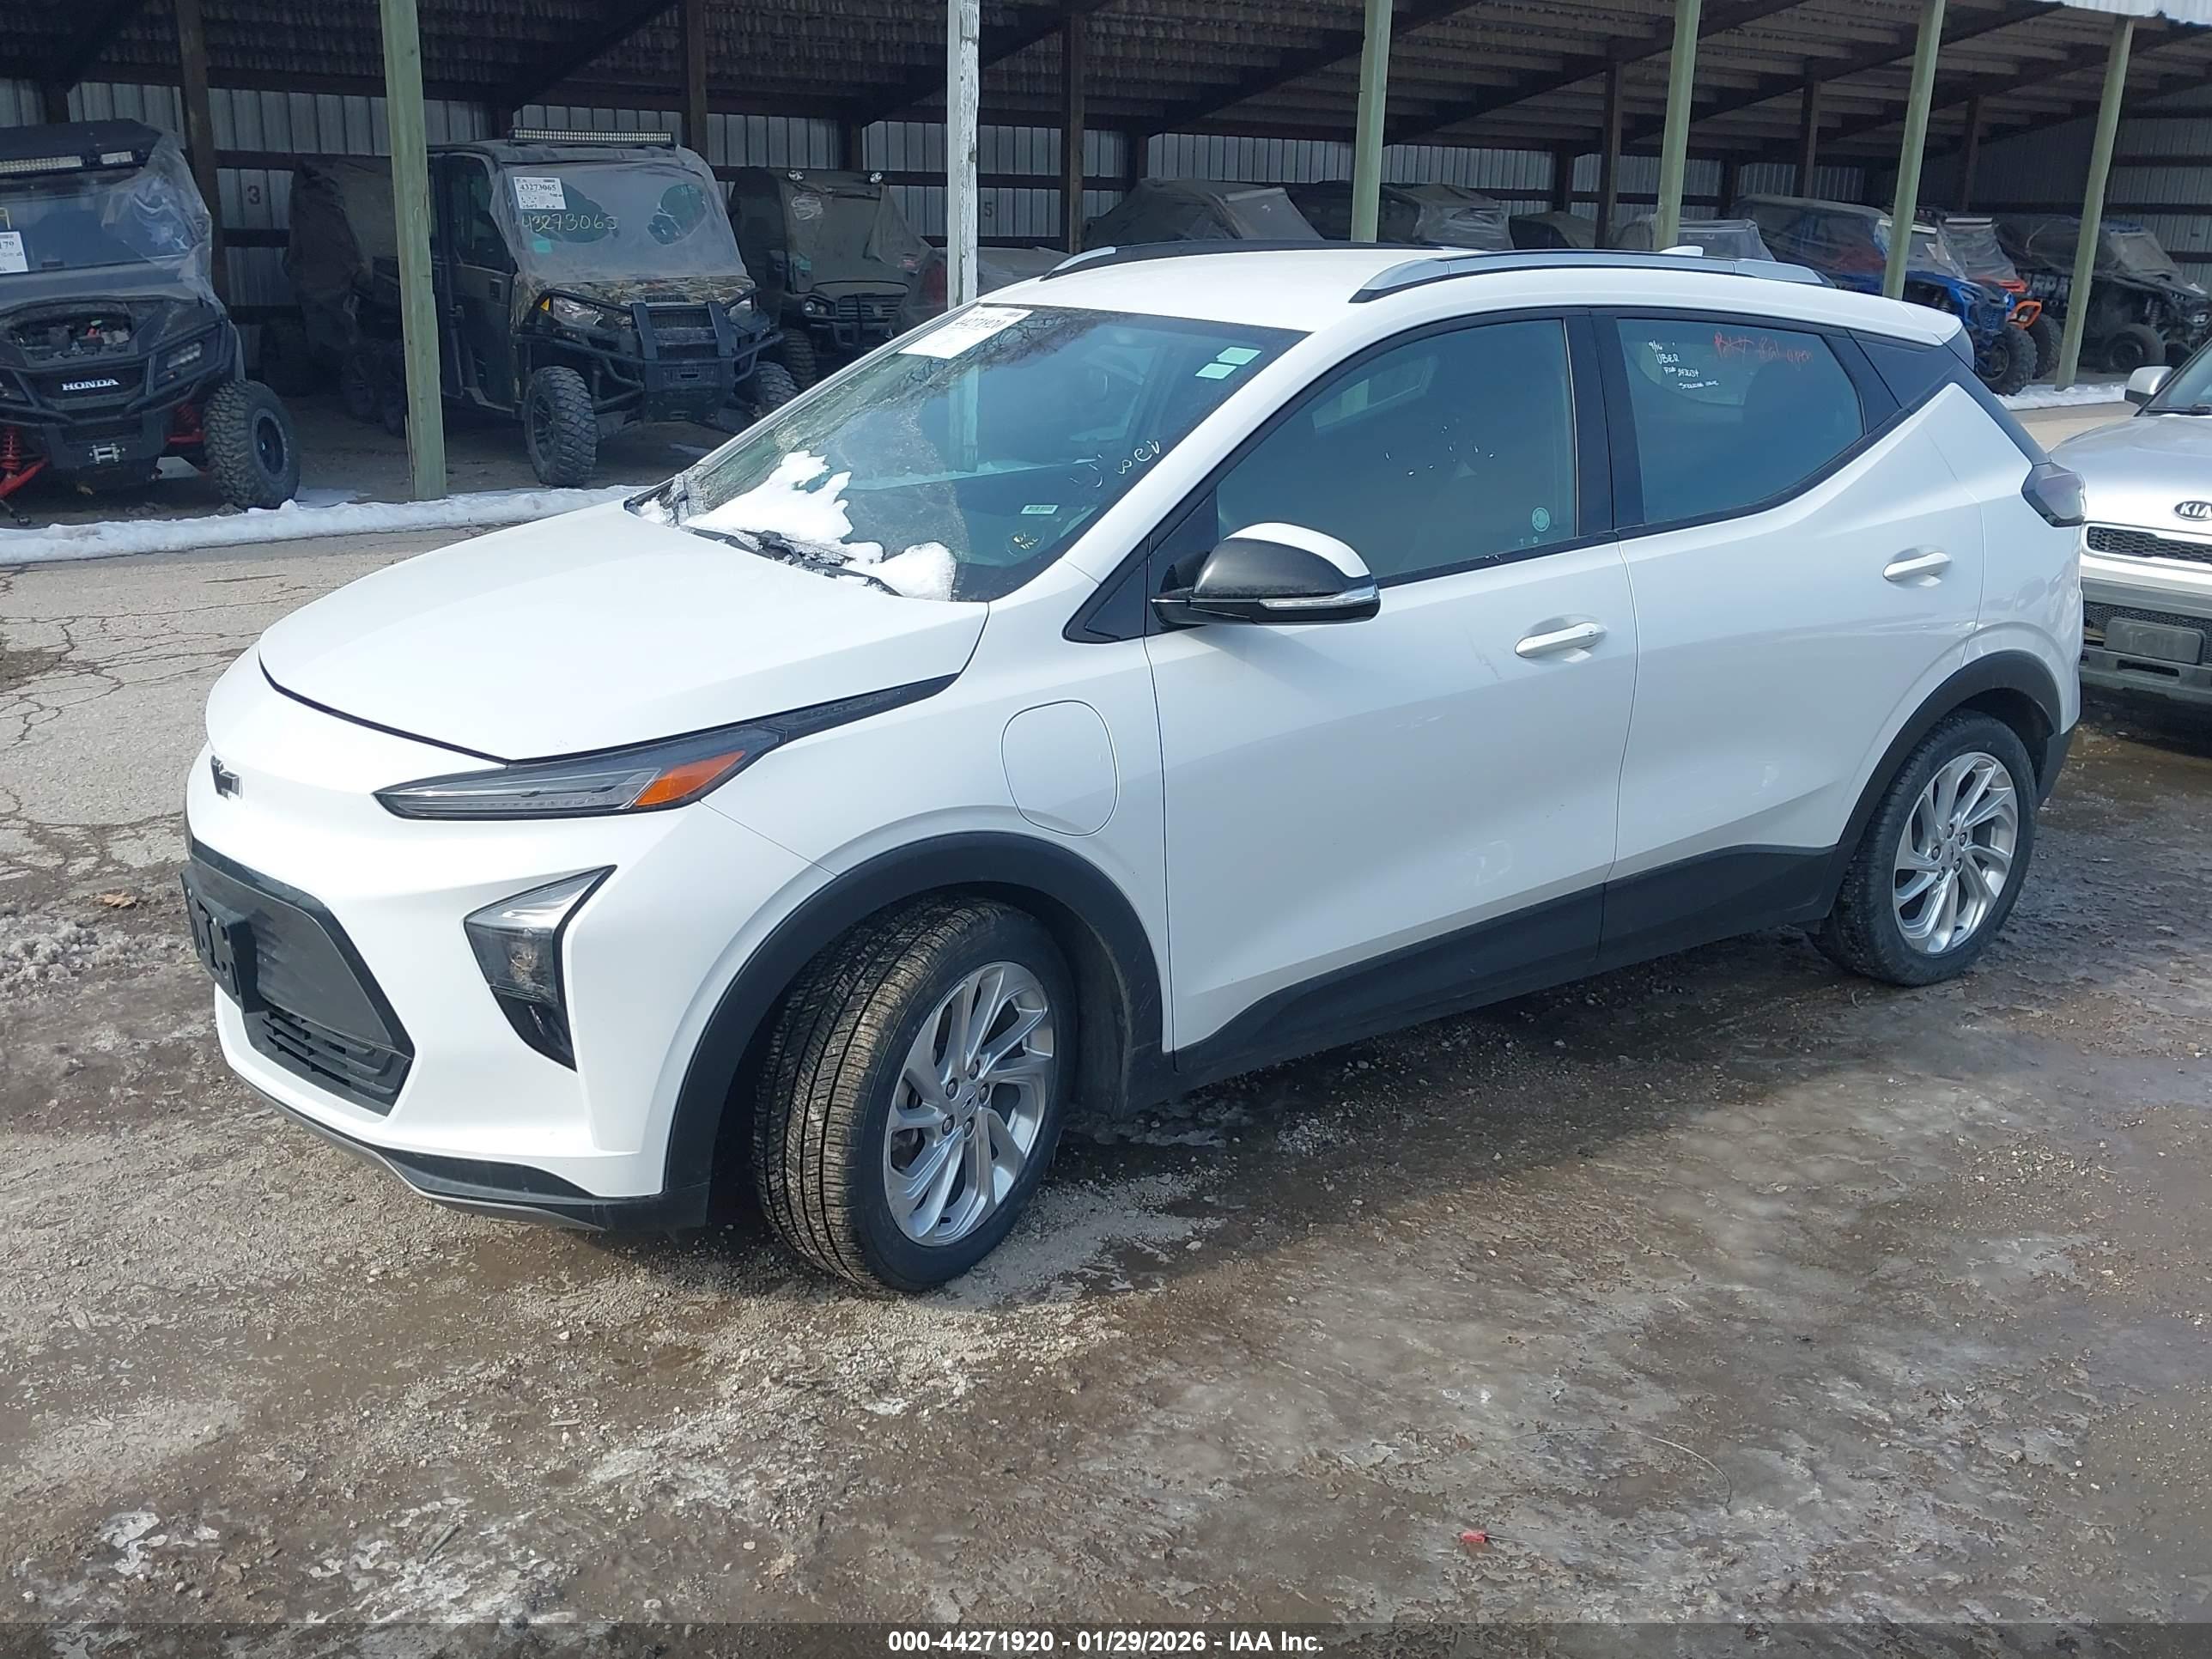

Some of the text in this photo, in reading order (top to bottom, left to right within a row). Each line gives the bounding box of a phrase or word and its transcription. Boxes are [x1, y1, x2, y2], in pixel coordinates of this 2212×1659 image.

[247, 185, 260, 205] 3
[984, 202, 993, 218] 5
[1656, 353, 1680, 365] UBER
[62, 379, 119, 391] HONDA
[2179, 502, 2212, 518] KIA
